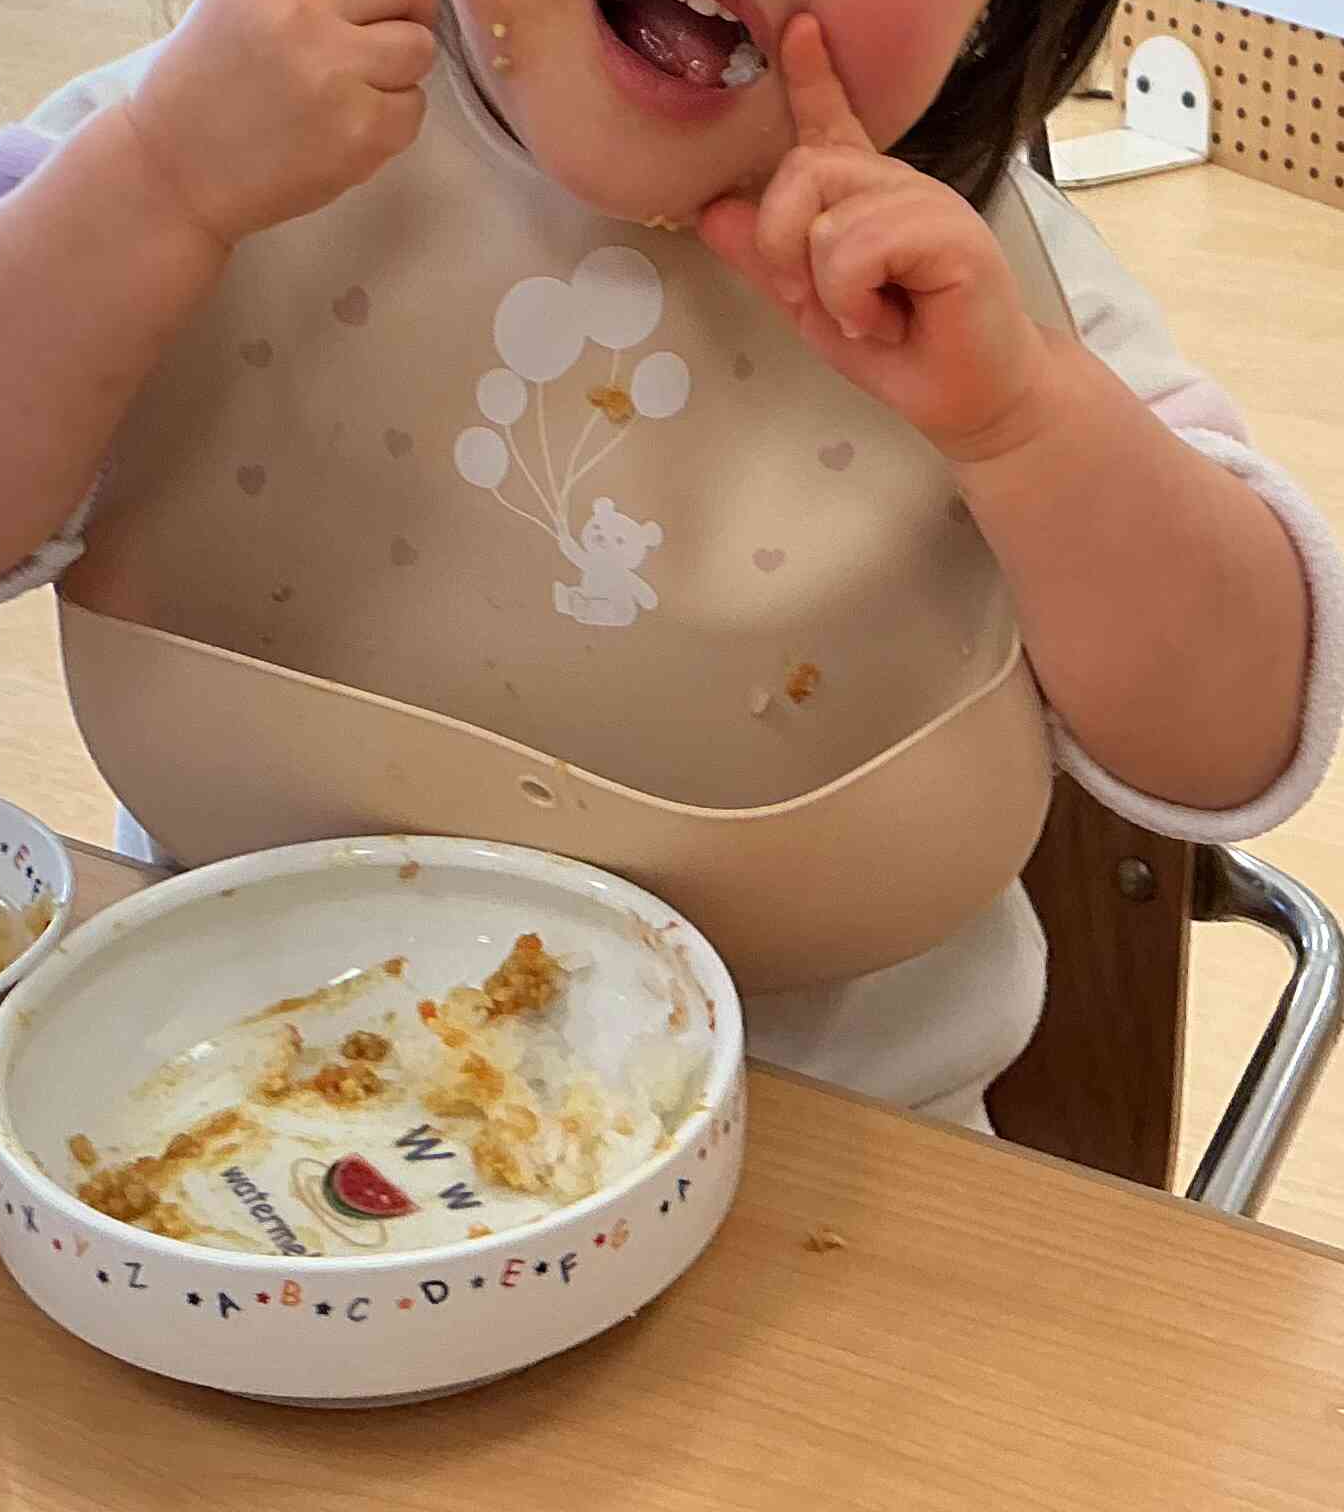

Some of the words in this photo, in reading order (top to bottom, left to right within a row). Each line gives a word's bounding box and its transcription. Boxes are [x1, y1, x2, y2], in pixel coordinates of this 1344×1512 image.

[394, 1124, 455, 1161] W
[221, 1166, 322, 1256] waterme
[21, 1205, 39, 1233] X
[123, 1262, 148, 1288] Z
[218, 1292, 242, 1319] A
[279, 1280, 301, 1306] B
[347, 1297, 370, 1322] C
[419, 1279, 449, 1304] D
[500, 1258, 526, 1288] E
[560, 1252, 578, 1284] F
